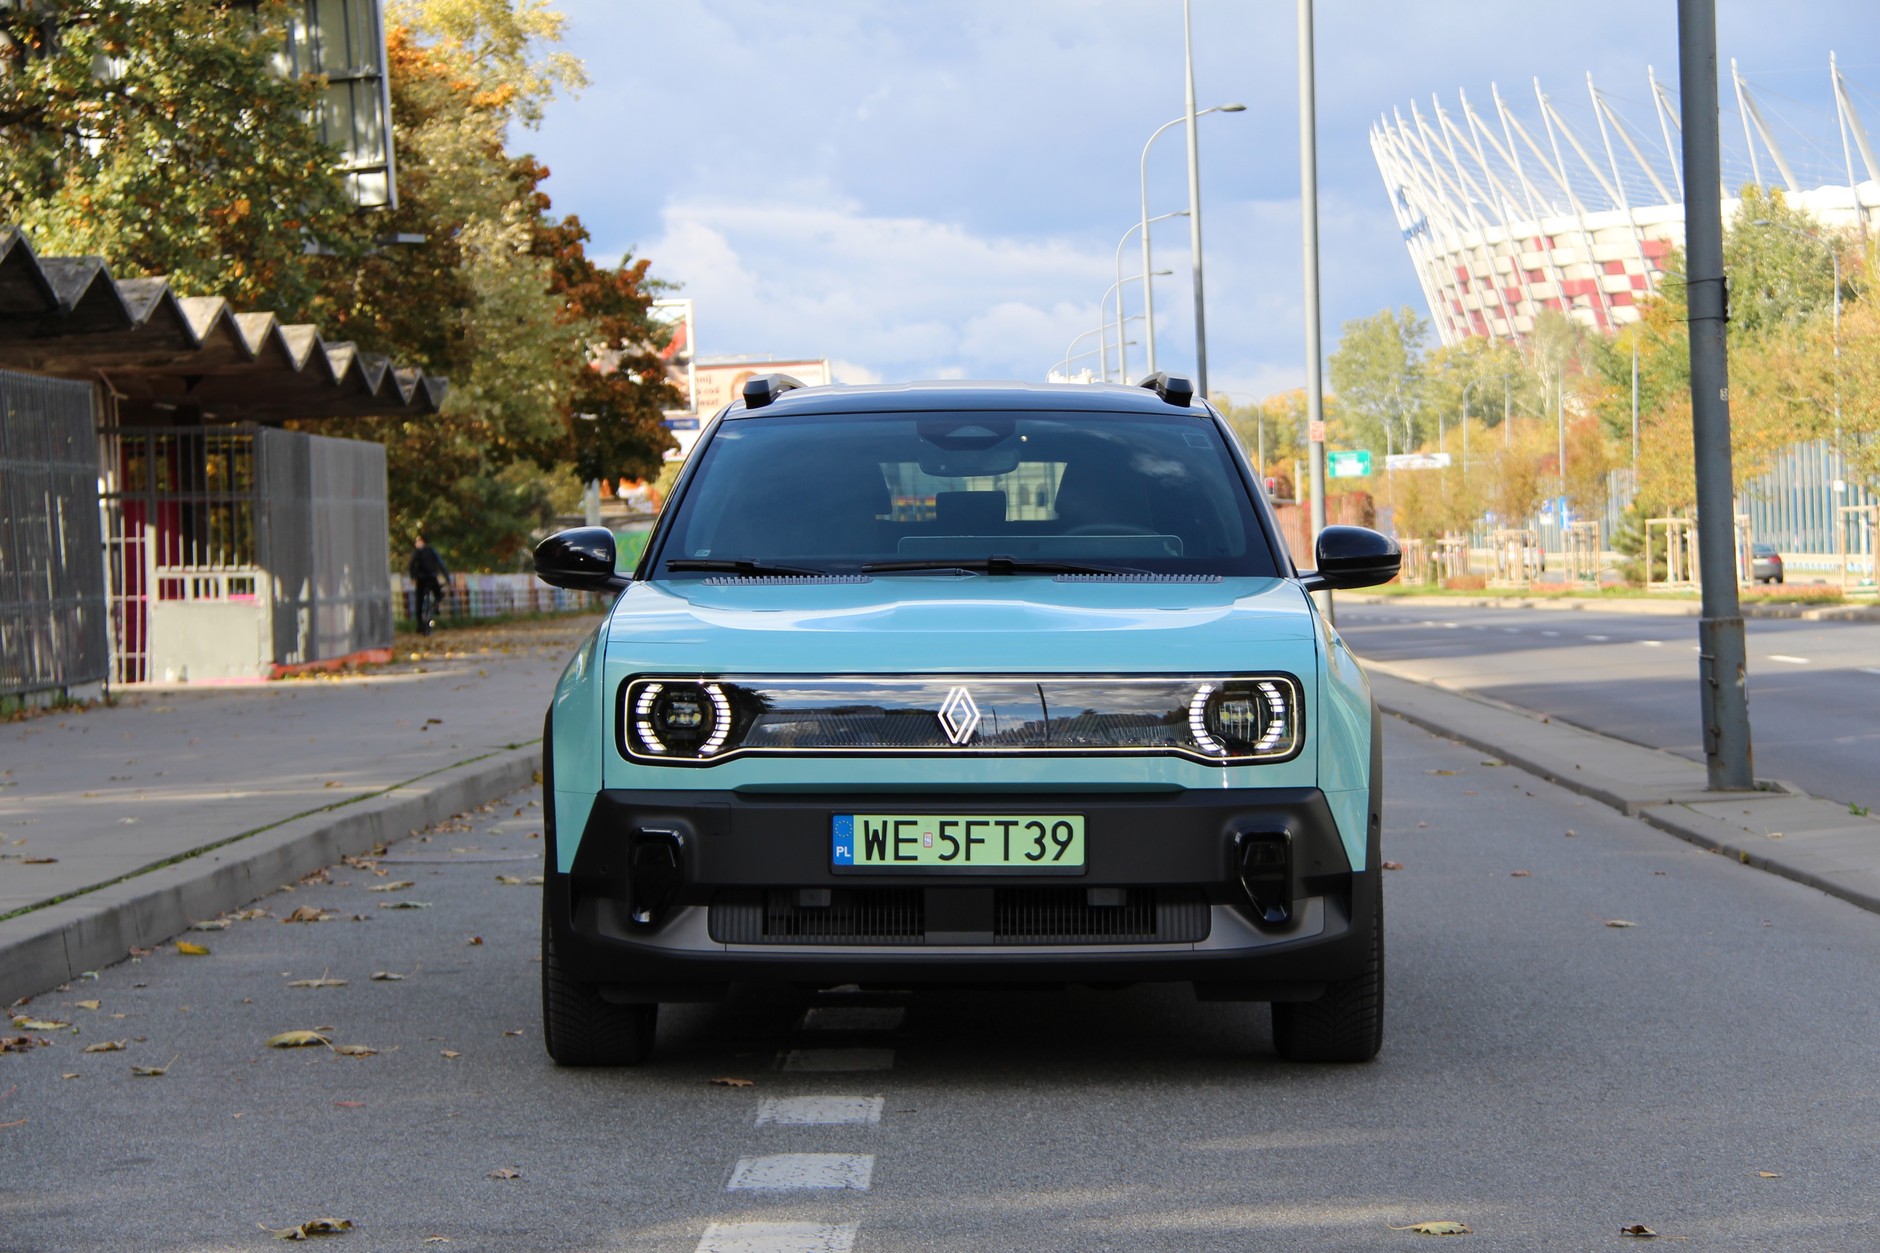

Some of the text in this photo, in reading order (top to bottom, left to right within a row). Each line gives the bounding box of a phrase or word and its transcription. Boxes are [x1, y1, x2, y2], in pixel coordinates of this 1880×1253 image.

[836, 846, 851, 857] PL
[863, 820, 1074, 861] WE 5FT39
